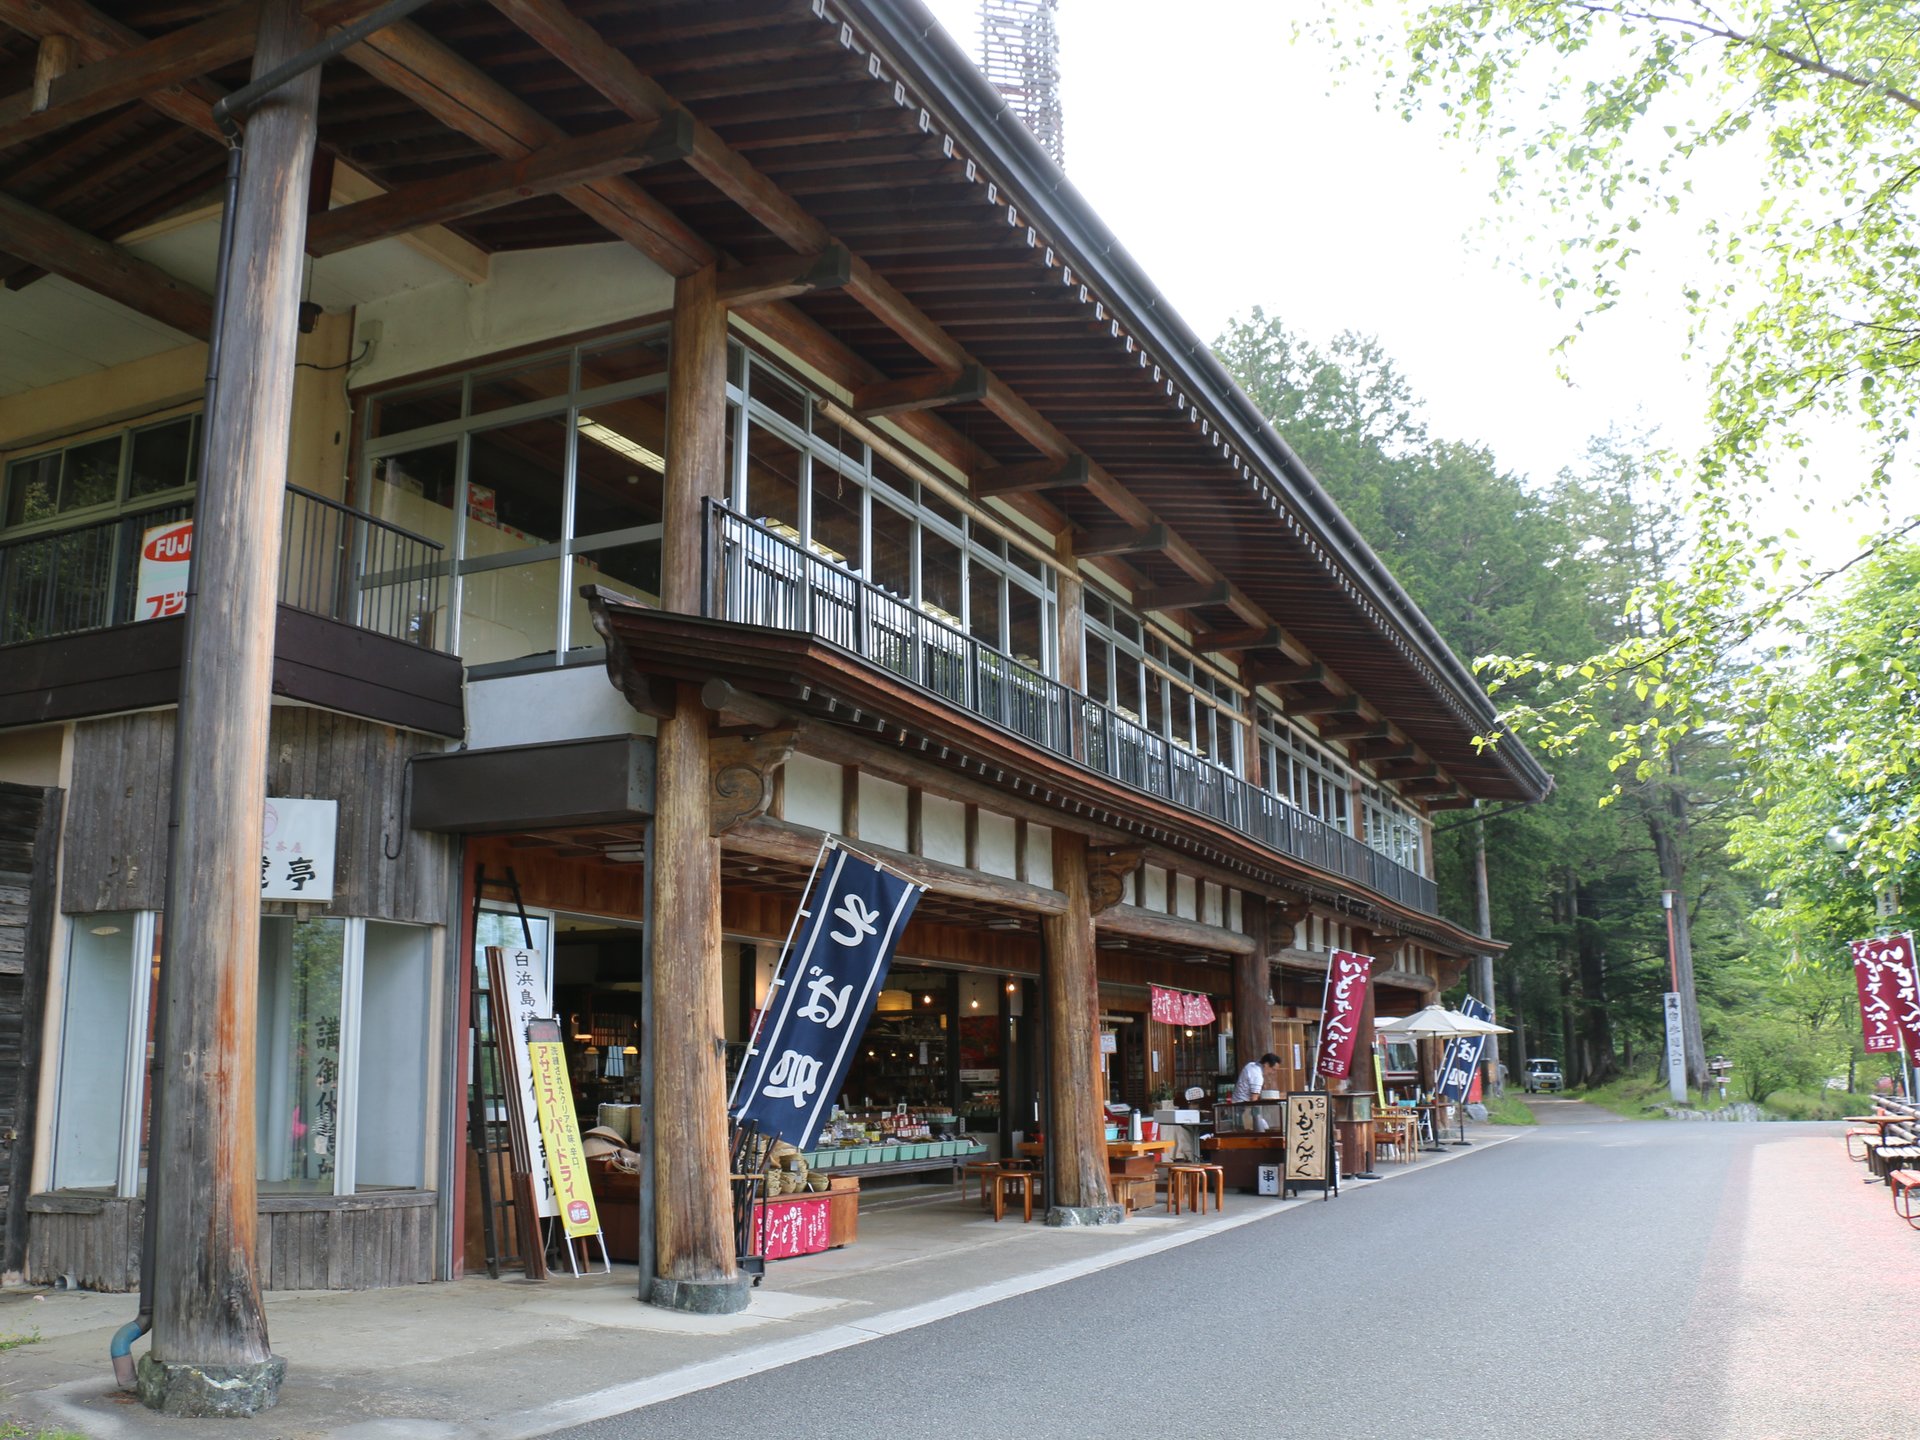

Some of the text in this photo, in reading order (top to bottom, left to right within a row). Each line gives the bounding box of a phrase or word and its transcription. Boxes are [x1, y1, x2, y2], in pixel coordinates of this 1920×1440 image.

[1326, 959, 1362, 1057] いもでんがく
[537, 1046, 575, 1199] アサヒスーパードライ
[1296, 1099, 1316, 1177] いもでんがく
[1263, 1169, 1275, 1182] 串
